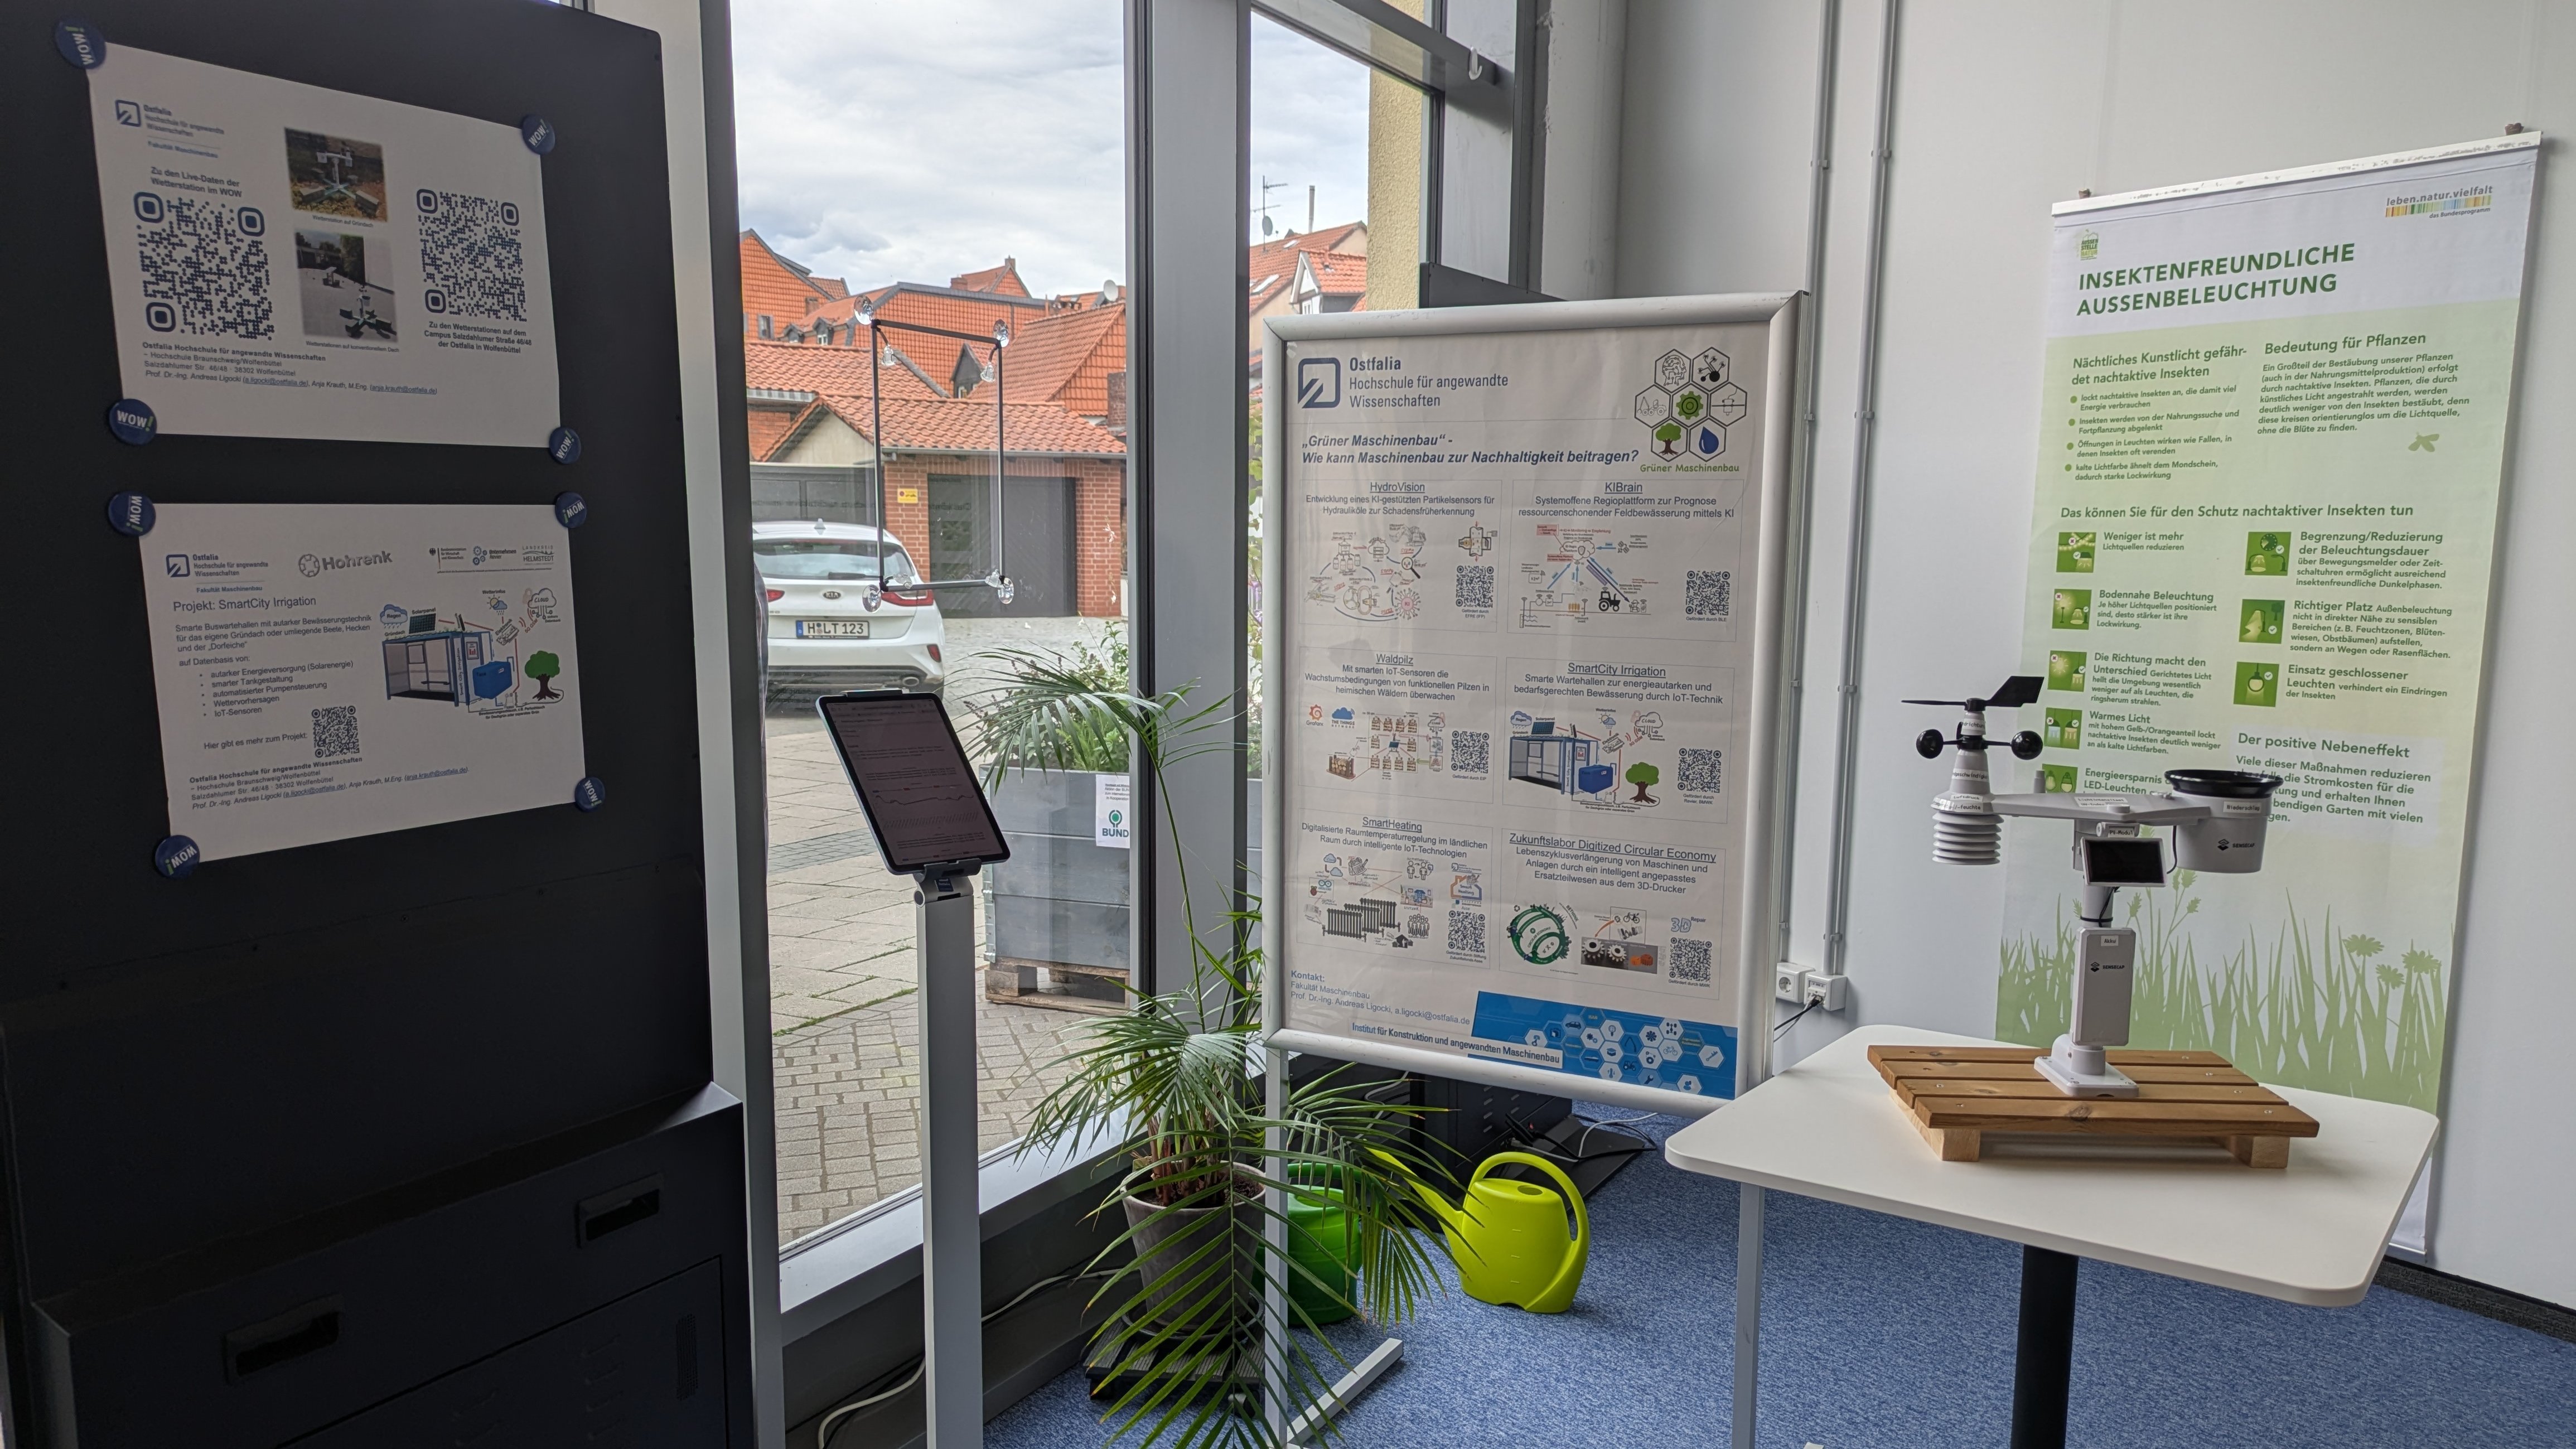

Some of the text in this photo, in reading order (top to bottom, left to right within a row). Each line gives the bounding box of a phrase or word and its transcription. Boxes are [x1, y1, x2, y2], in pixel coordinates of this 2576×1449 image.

[66, 26, 94, 65] WOW!
[529, 119, 549, 146] WOW!
[151, 167, 162, 175] Zu
[181, 172, 224, 185] Live-Daten
[151, 177, 205, 192] Wetterstation
[219, 187, 242, 197] WOW
[2387, 185, 2492, 206] leben.natur.vielfalt
[2440, 208, 2490, 217] Bundesprogramm
[2080, 243, 2355, 290] INSEKTENFREUNDLICHE
[2077, 274, 2336, 316] AUSSENBELEUCHTUNG
[424, 330, 451, 339] Campus
[453, 332, 494, 342] Salzdahlumer
[453, 323, 501, 334] Wetterstationen
[483, 344, 520, 353] Wolfenbüttel
[2265, 334, 2425, 354] Bedeutung für Pflanzen
[1350, 356, 1400, 371] Ostfalia
[2074, 345, 2246, 368] Nächtliches Kunstlicht gefähr-
[1350, 374, 1508, 390] Hochschule für angewandte
[2072, 366, 2209, 385] det nachtaktive Insekten
[1350, 394, 1440, 407] Wissenschaften
[117, 410, 154, 432] WOW!
[556, 430, 574, 460] WOW!
[1303, 452, 1323, 463] Wie
[1326, 452, 1354, 463] kann
[1358, 452, 1444, 463] Maschinenbau
[1471, 451, 1564, 465] Nachhaltigkeit
[1567, 450, 1639, 465] beitragen?
[1676, 463, 1739, 472] Maschinenbau
[1370, 482, 1425, 494] HydroVision
[1606, 482, 1642, 492] KIBrain
[1306, 495, 1348, 504] Entwicklung
[1371, 495, 1420, 505] KI-gestützten
[1536, 496, 1591, 506] Systemoffene
[1594, 496, 1655, 506] Regioplattform
[1674, 496, 1716, 507] Prognose
[126, 495, 143, 532] WOW!
[562, 501, 585, 524] WOW!
[2061, 504, 2413, 518] Das können Sie für den Schutz nachtaktiver Insekten tun
[2104, 532, 2142, 542] Weniger
[2159, 532, 2184, 540] mehr
[2300, 532, 2443, 544] Begrenzung/Reduzierung
[2299, 545, 2429, 558] der Beleuchtungsdauer
[321, 550, 393, 571] Hohrenk
[2100, 590, 2213, 603] Bodennahe Beleuchtung
[173, 596, 316, 614] Projekt: SmartCity Irrigation
[2294, 600, 2452, 616] Richtiger Platz Außenbeleuchtung
[205, 621, 258, 630] Buswartehallen
[302, 615, 371, 625] Bewässerungstechnik
[808, 623, 815, 634] H
[842, 623, 864, 634] 123
[1376, 654, 1413, 666] Waldpilz
[2095, 653, 2206, 666] Die Richtung macht den
[1568, 663, 1666, 677] SmartCity Irrigation
[2288, 664, 2408, 679] Einsatz geschlossener
[214, 697, 279, 707] Wettervorhersagen
[214, 708, 262, 717] IoT-Sensoren
[2090, 711, 2150, 723] Warmes Licht
[221, 741, 234, 749] gibt
[282, 733, 307, 741] Projekt:
[2239, 733, 2410, 757] Der positive Nebeneffekt
[584, 780, 602, 806] WOW!
[1362, 817, 1422, 833] SmartHeating
[1102, 828, 1129, 838] BUND
[1509, 833, 1717, 862] Zukunftslabor Digitized Circular Economy
[165, 846, 197, 875] WOW!
[1292, 970, 1325, 982] Kontakt:
[1291, 981, 1370, 999] Fakultät Maschinenbau
[1352, 1022, 1559, 1063] Institut für Konstruktion und angewandten Maschinenbau
